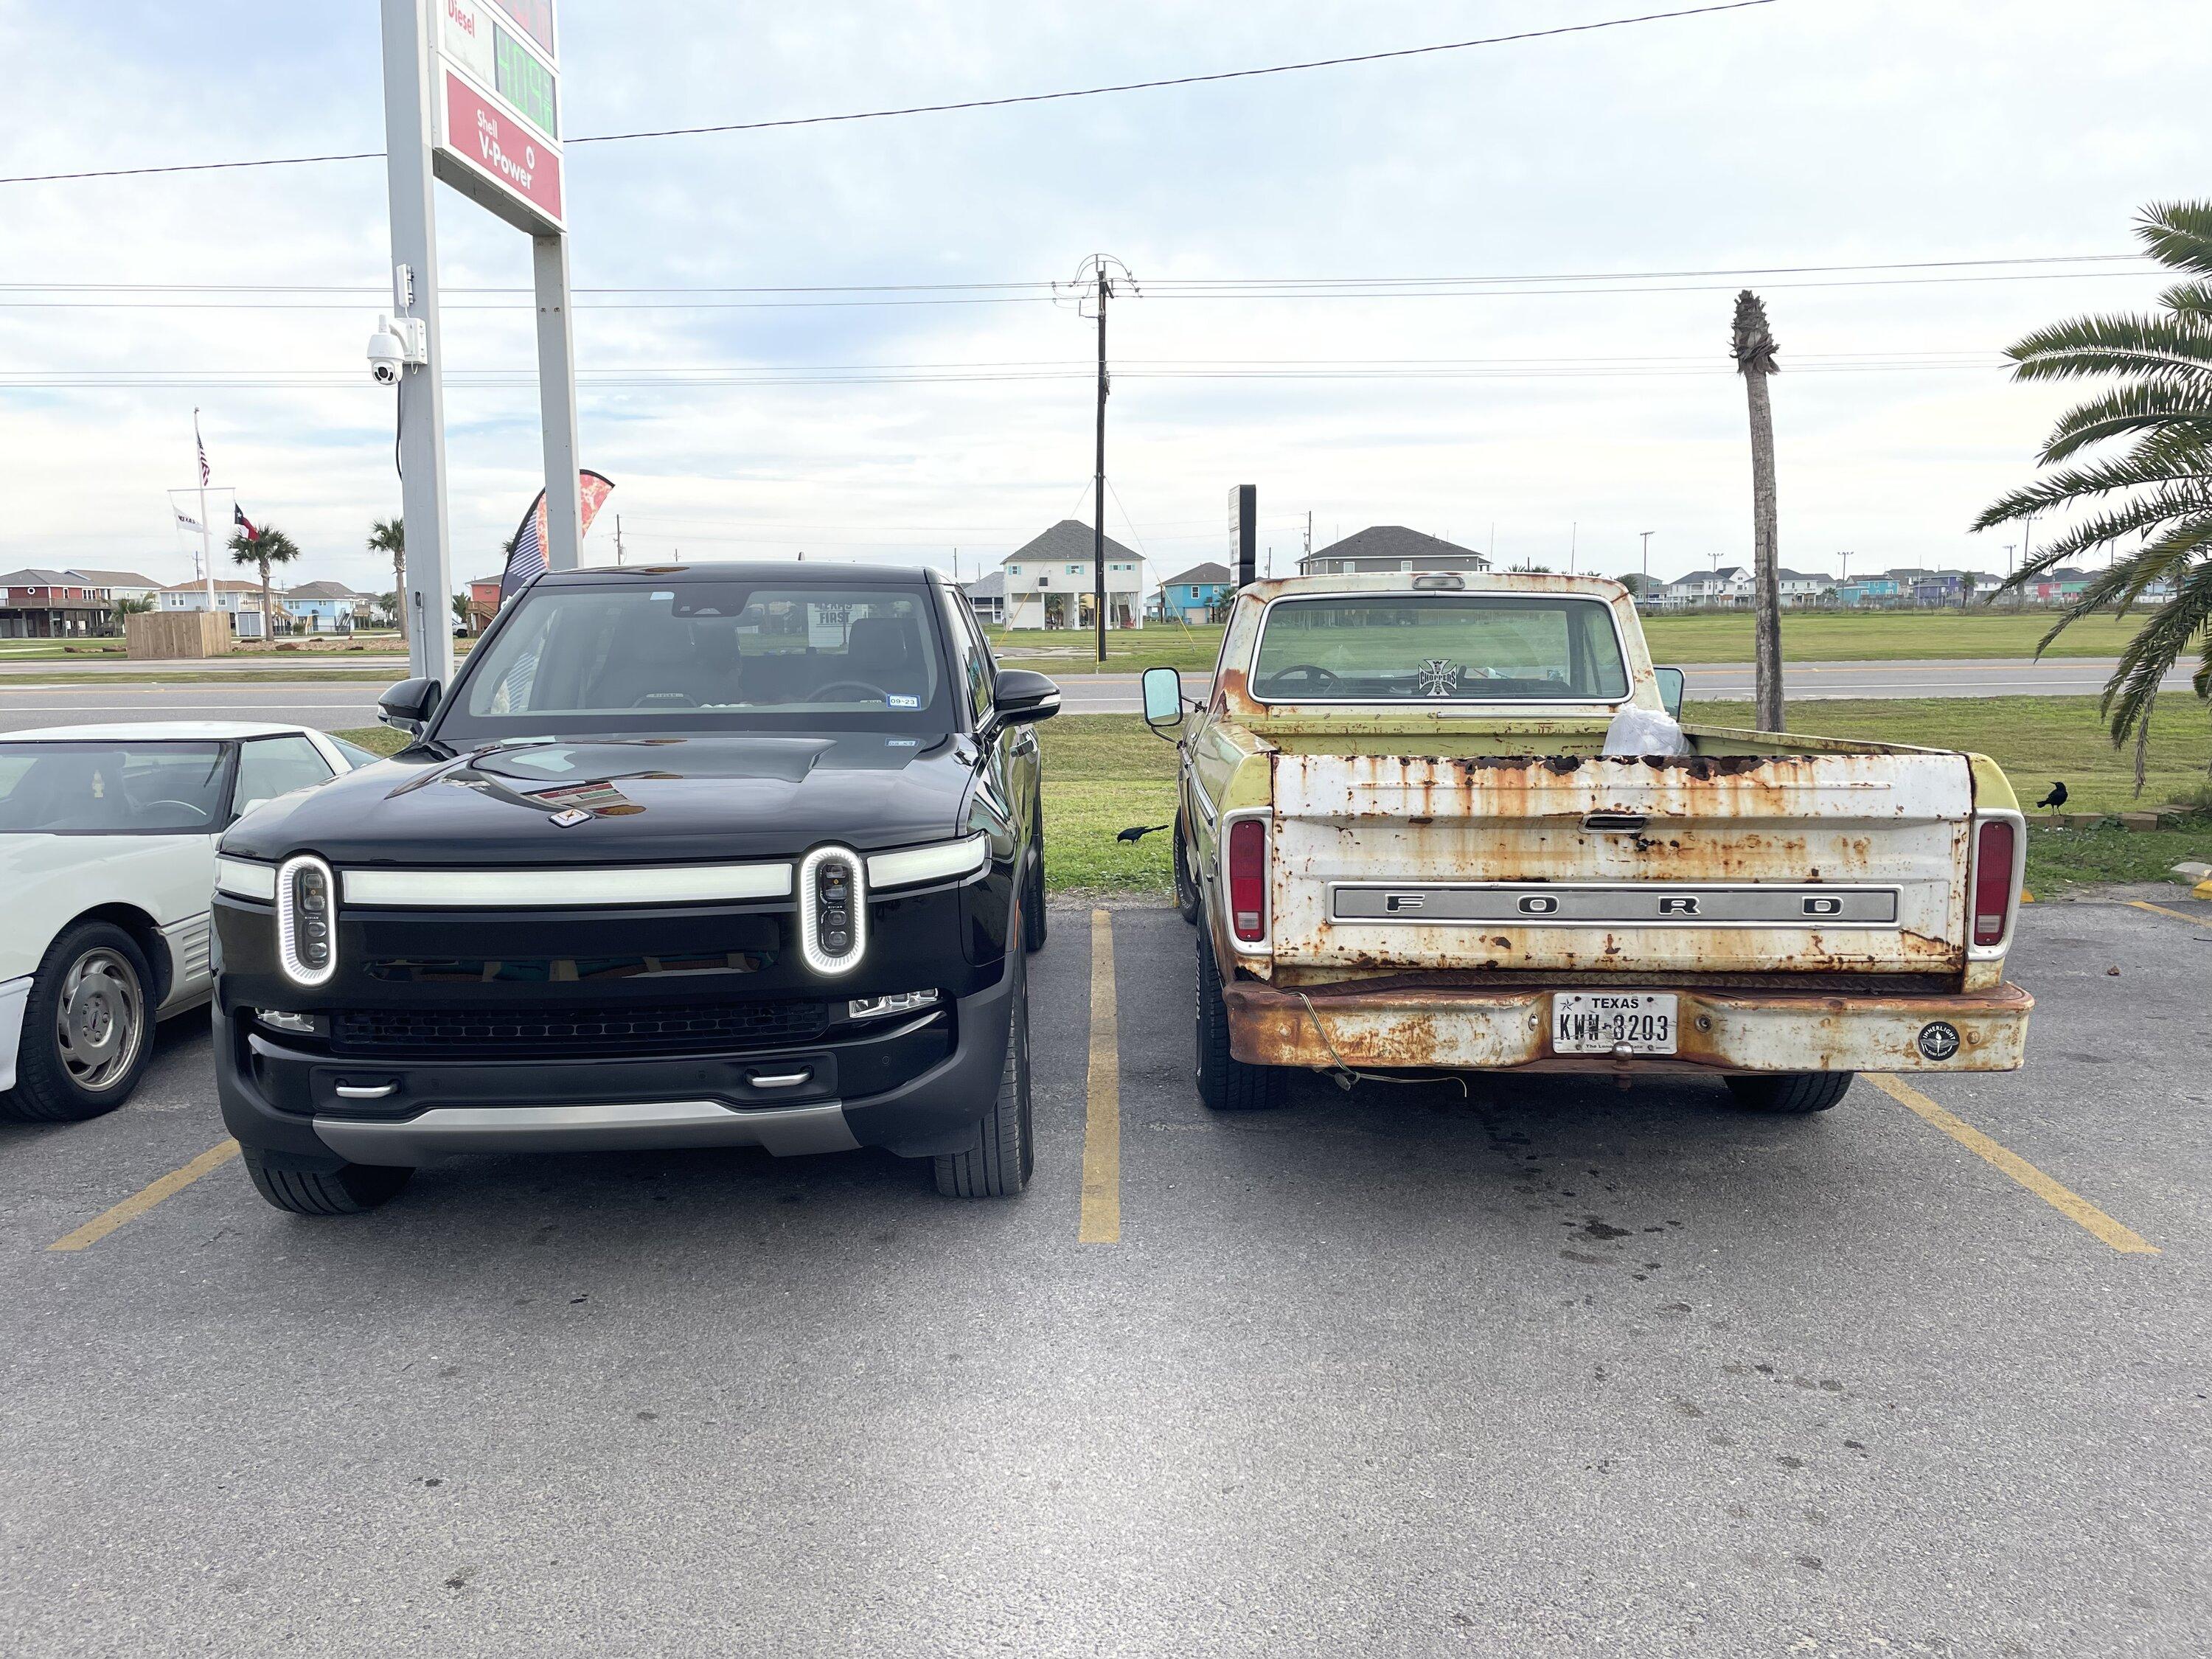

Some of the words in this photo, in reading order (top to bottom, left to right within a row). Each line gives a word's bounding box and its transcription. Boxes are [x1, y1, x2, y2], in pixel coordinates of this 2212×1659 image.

[448, 0, 476, 38] Diesel
[477, 108, 498, 139] Shell
[479, 131, 532, 189] V-Power
[820, 612, 850, 624] FIRST
[1420, 671, 1455, 685] CHOPPERS
[1385, 894, 1844, 916] FORD
[1591, 998, 1639, 1009] TEXAS
[1922, 1025, 1956, 1040] INNERLIGHT
